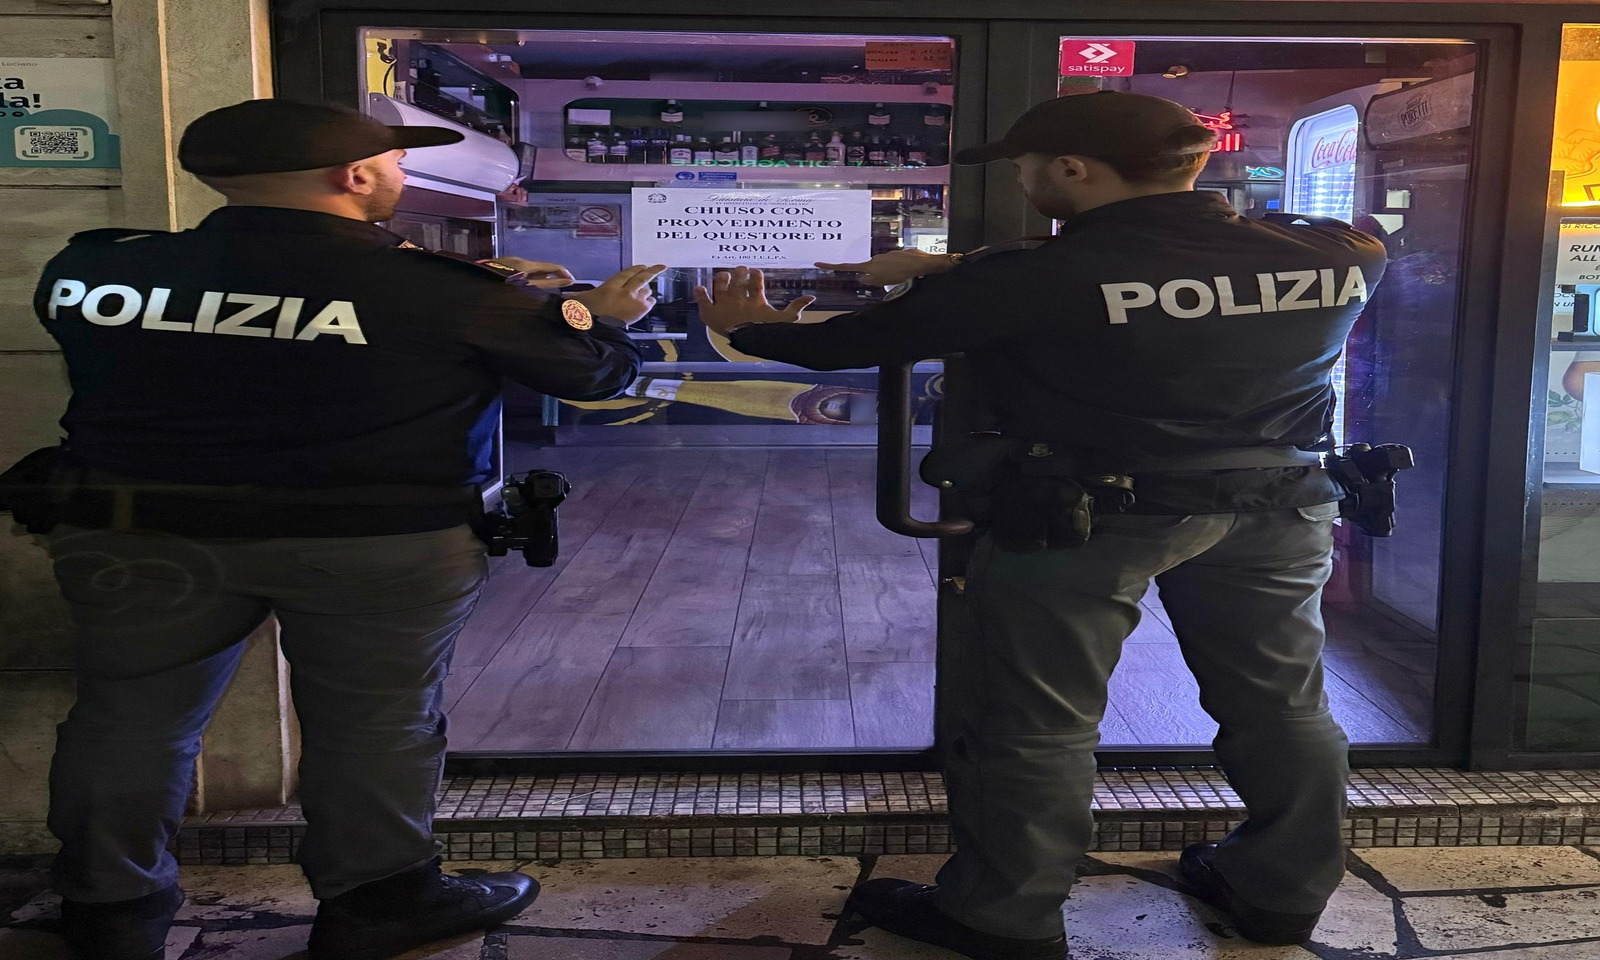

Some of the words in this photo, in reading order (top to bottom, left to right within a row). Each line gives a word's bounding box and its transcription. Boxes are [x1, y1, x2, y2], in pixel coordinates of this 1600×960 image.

[1068, 64, 1126, 74] satispay
[684, 206, 765, 215] CHIUSO
[770, 207, 815, 215] CON
[657, 218, 843, 228] PROVVEDIMENTO
[656, 231, 697, 240] DEL
[703, 231, 815, 241] QUESTORE
[822, 232, 842, 241] DI
[718, 244, 782, 253] ROMA
[1100, 266, 1368, 325] POLIZIA
[48, 278, 368, 345] POLIZIA
